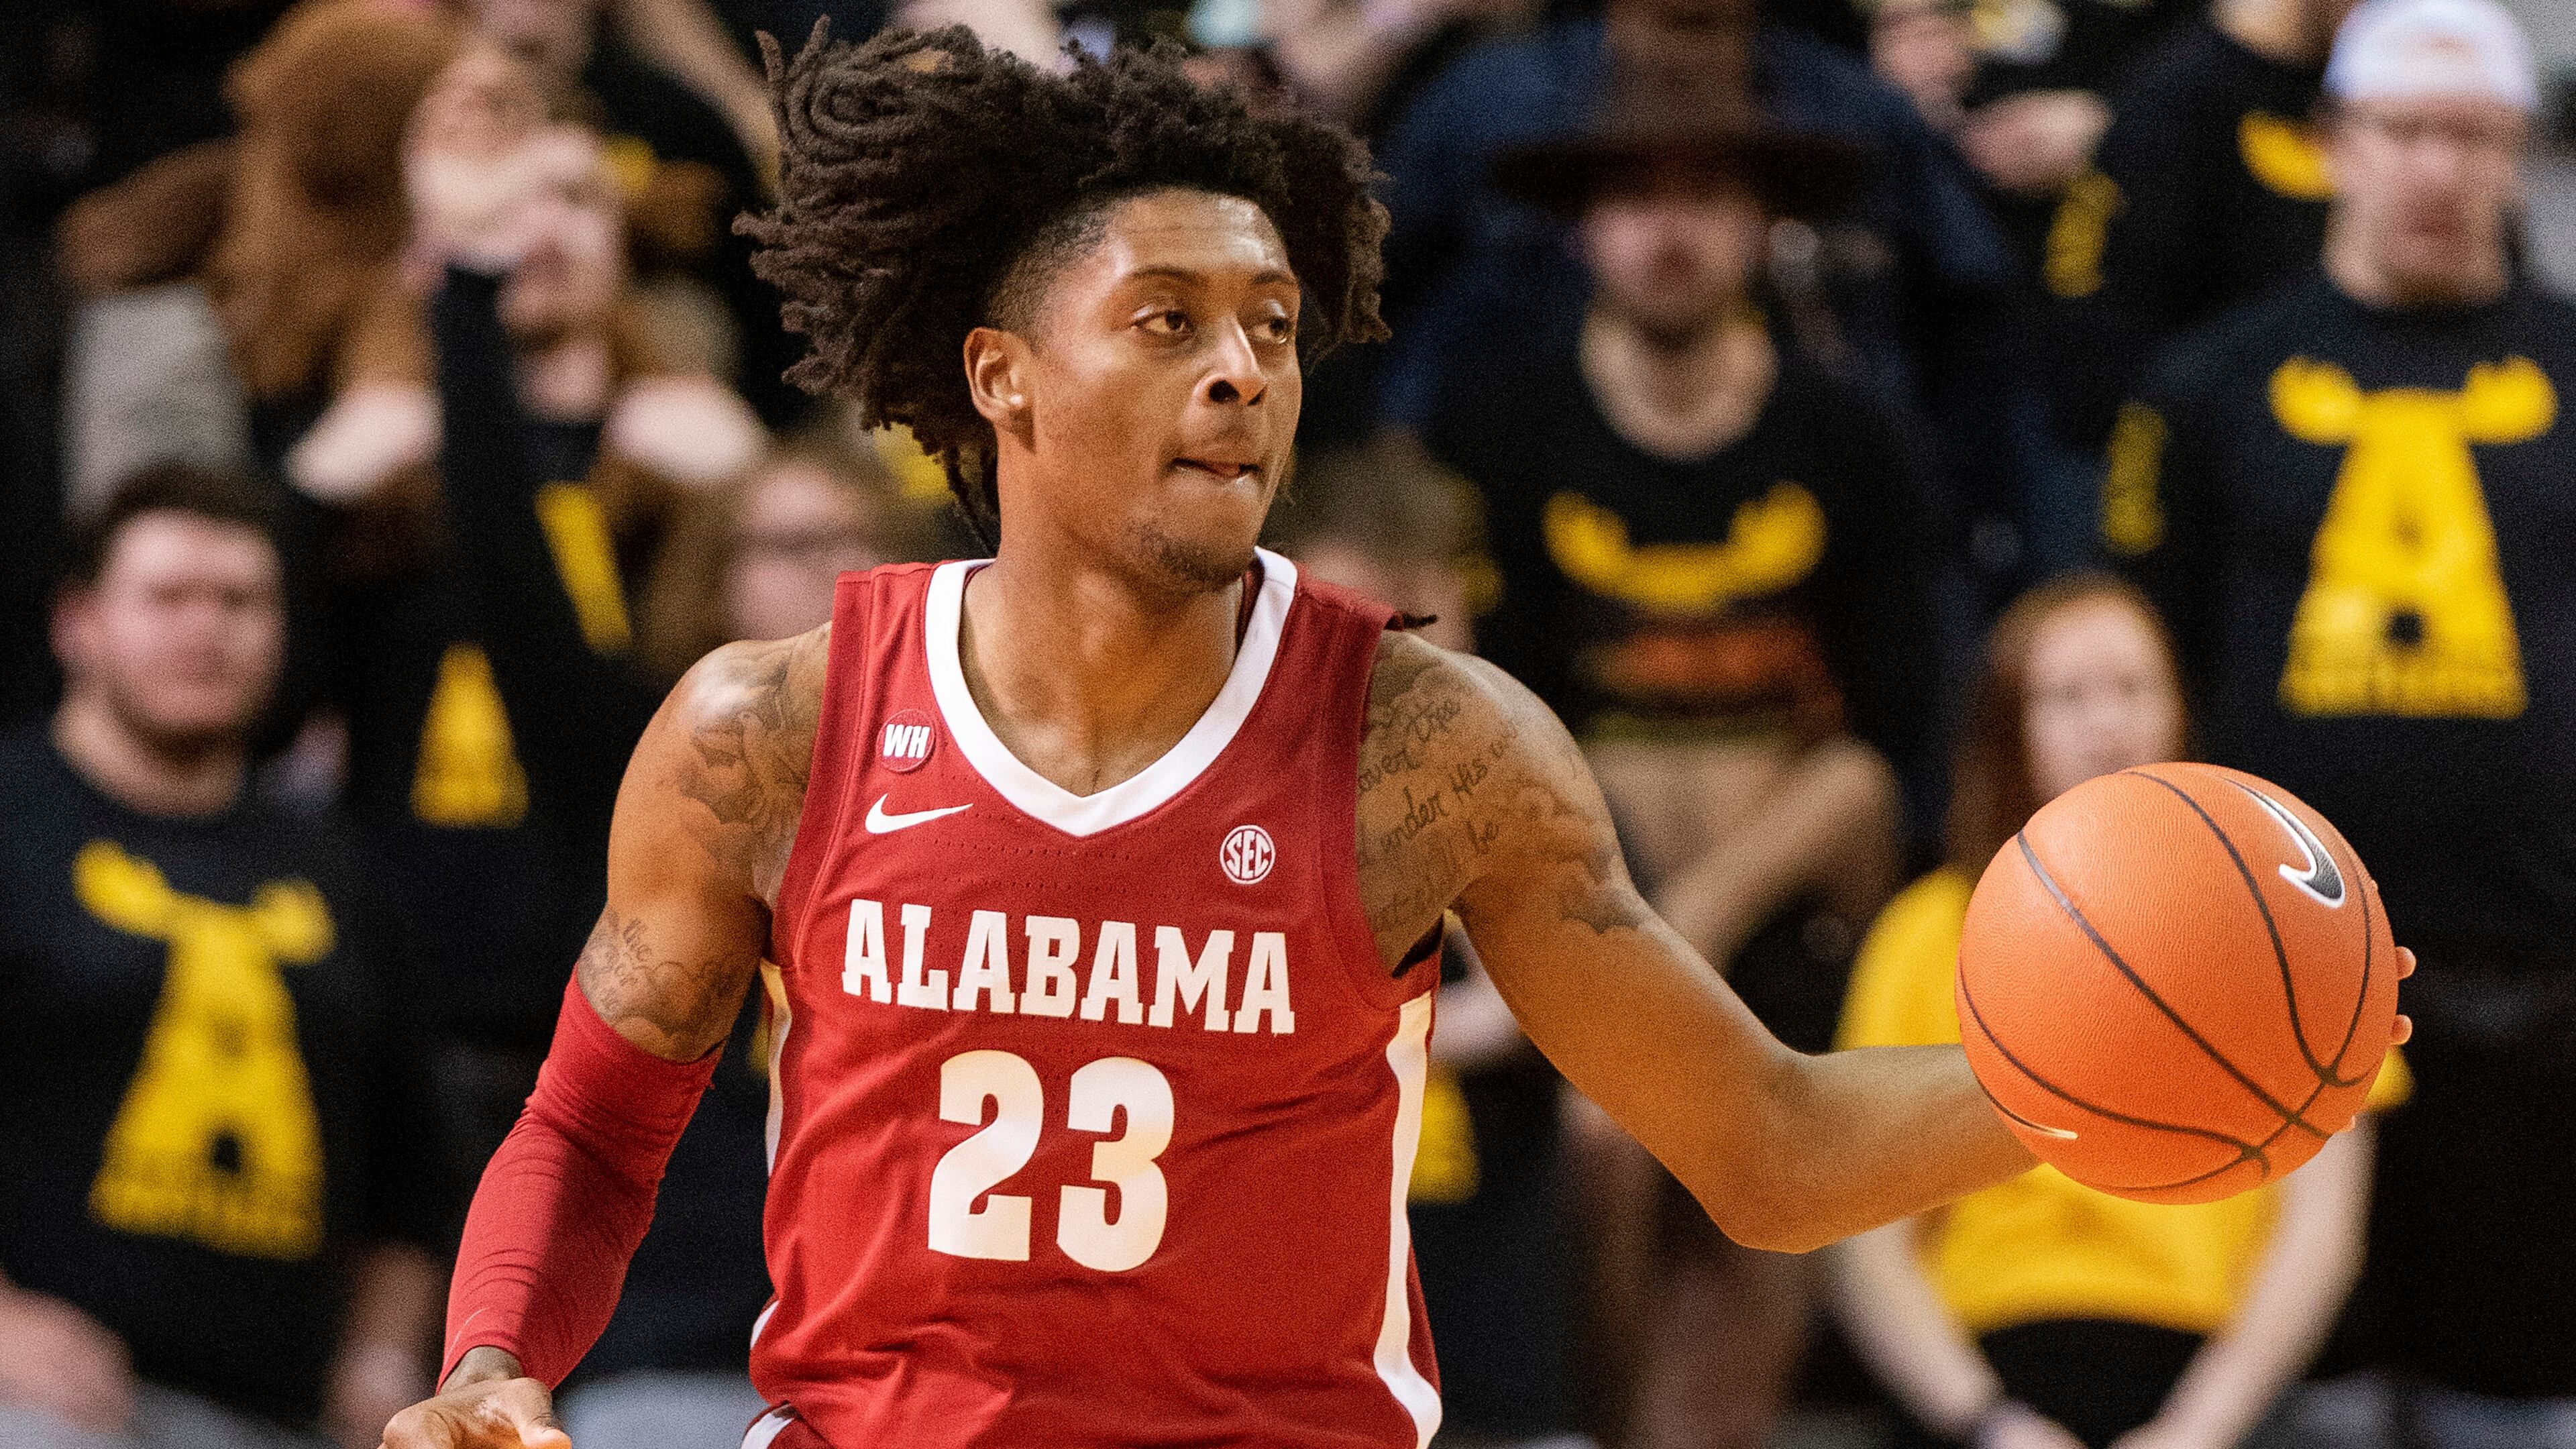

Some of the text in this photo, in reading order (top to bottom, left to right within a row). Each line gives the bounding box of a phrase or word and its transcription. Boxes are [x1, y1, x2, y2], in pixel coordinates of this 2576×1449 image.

[882, 724, 931, 759] WH
[1227, 830, 1270, 878] SEC
[842, 898, 1295, 1034] ALABAMA
[928, 1049, 1175, 1273] 23
